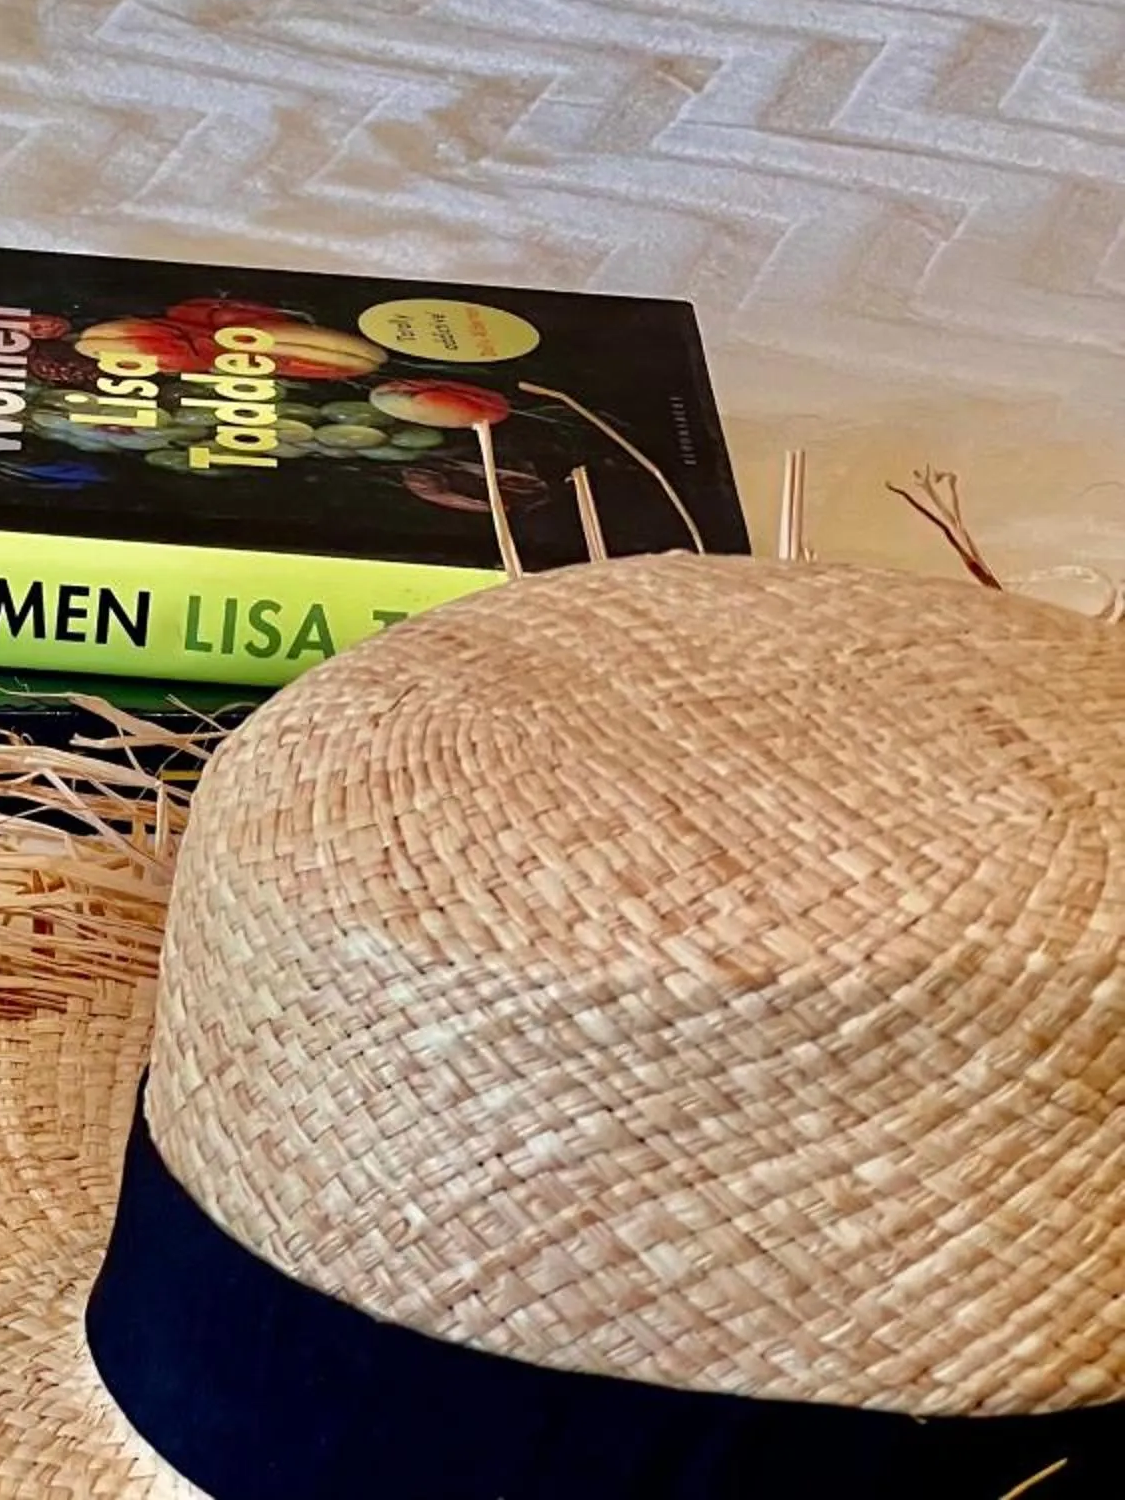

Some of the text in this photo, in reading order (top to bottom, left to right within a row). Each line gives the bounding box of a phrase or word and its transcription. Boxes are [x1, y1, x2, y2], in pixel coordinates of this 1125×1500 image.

[65, 350, 159, 428] Lisa
[180, 326, 278, 468] Taddeo
[184, 594, 337, 660] LISA
